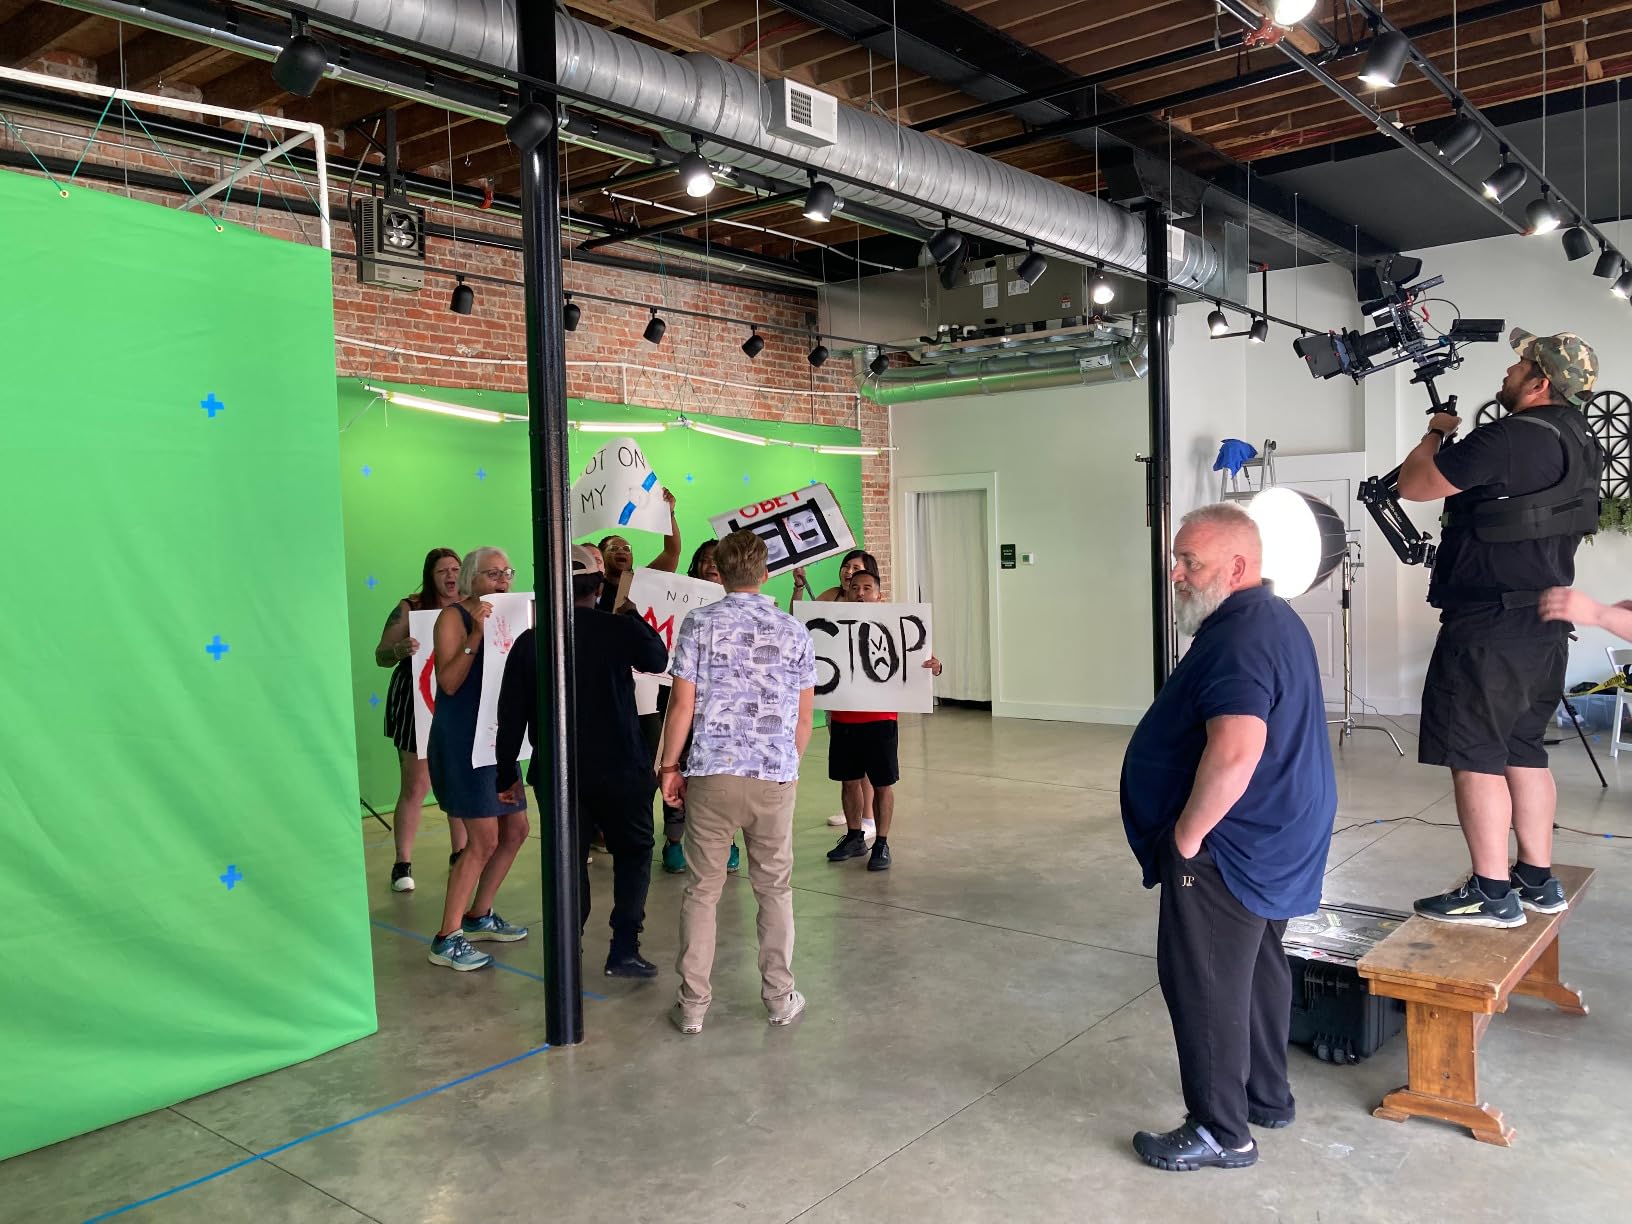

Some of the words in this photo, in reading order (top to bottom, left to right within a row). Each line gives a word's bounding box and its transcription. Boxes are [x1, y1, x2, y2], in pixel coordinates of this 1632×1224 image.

[618, 446, 646, 469] ON
[580, 484, 607, 513] MY
[666, 590, 709, 606] NOT
[805, 614, 926, 696] STOP
